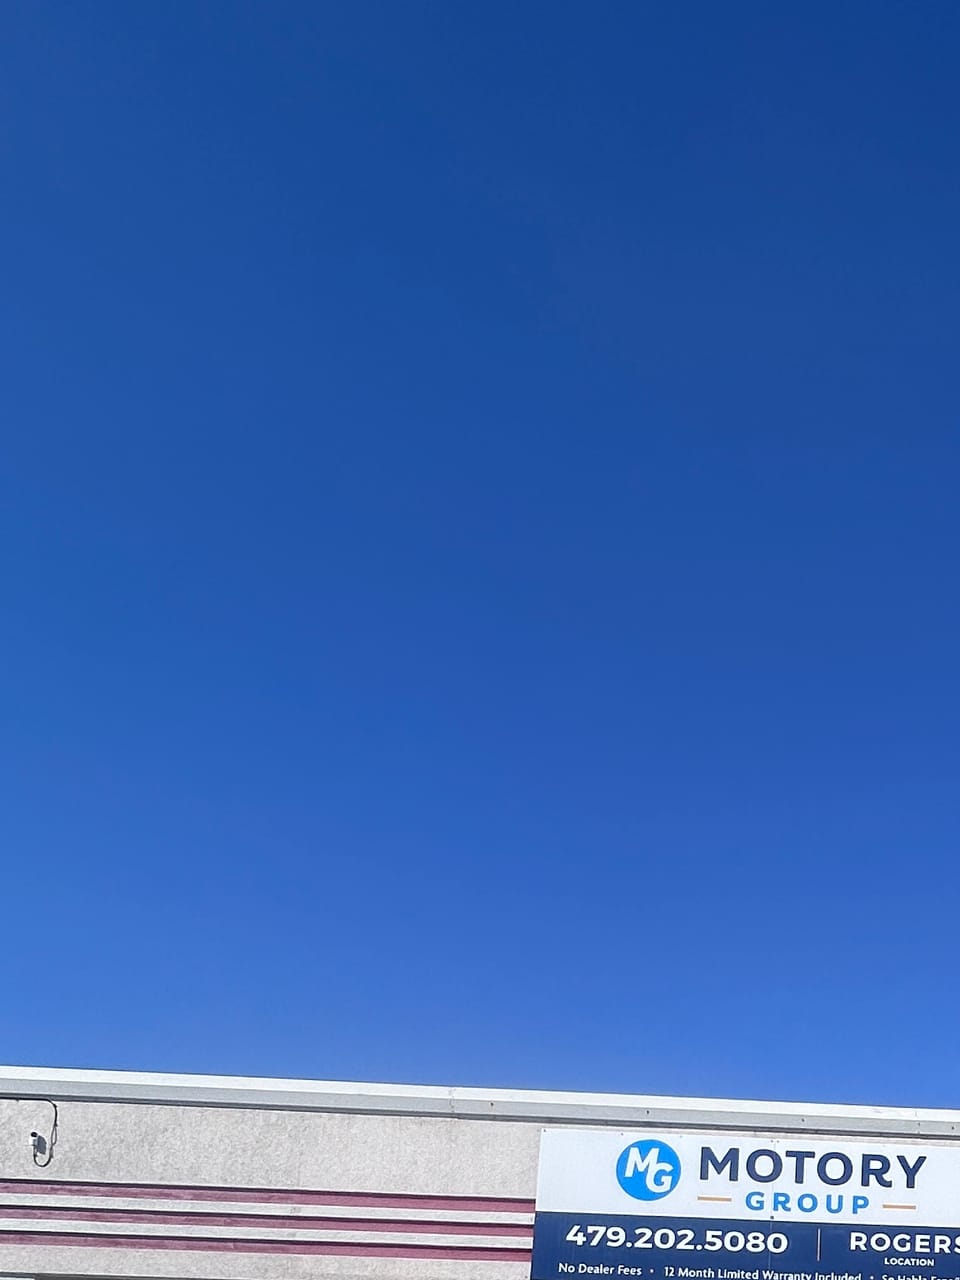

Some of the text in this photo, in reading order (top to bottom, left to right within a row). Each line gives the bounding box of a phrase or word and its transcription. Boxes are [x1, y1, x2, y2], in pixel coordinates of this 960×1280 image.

[624, 1147, 674, 1193] MG
[699, 1147, 928, 1189] MOTORY
[745, 1191, 870, 1214] GROUP
[565, 1225, 789, 1254] 479.202.5080
[558, 1263, 642, 1276] No Dealer Fees
[664, 1266, 675, 1277] 12
[678, 1267, 715, 1279] Month
[717, 1268, 759, 1280] Limited
[884, 1257, 935, 1267] LOCATION
